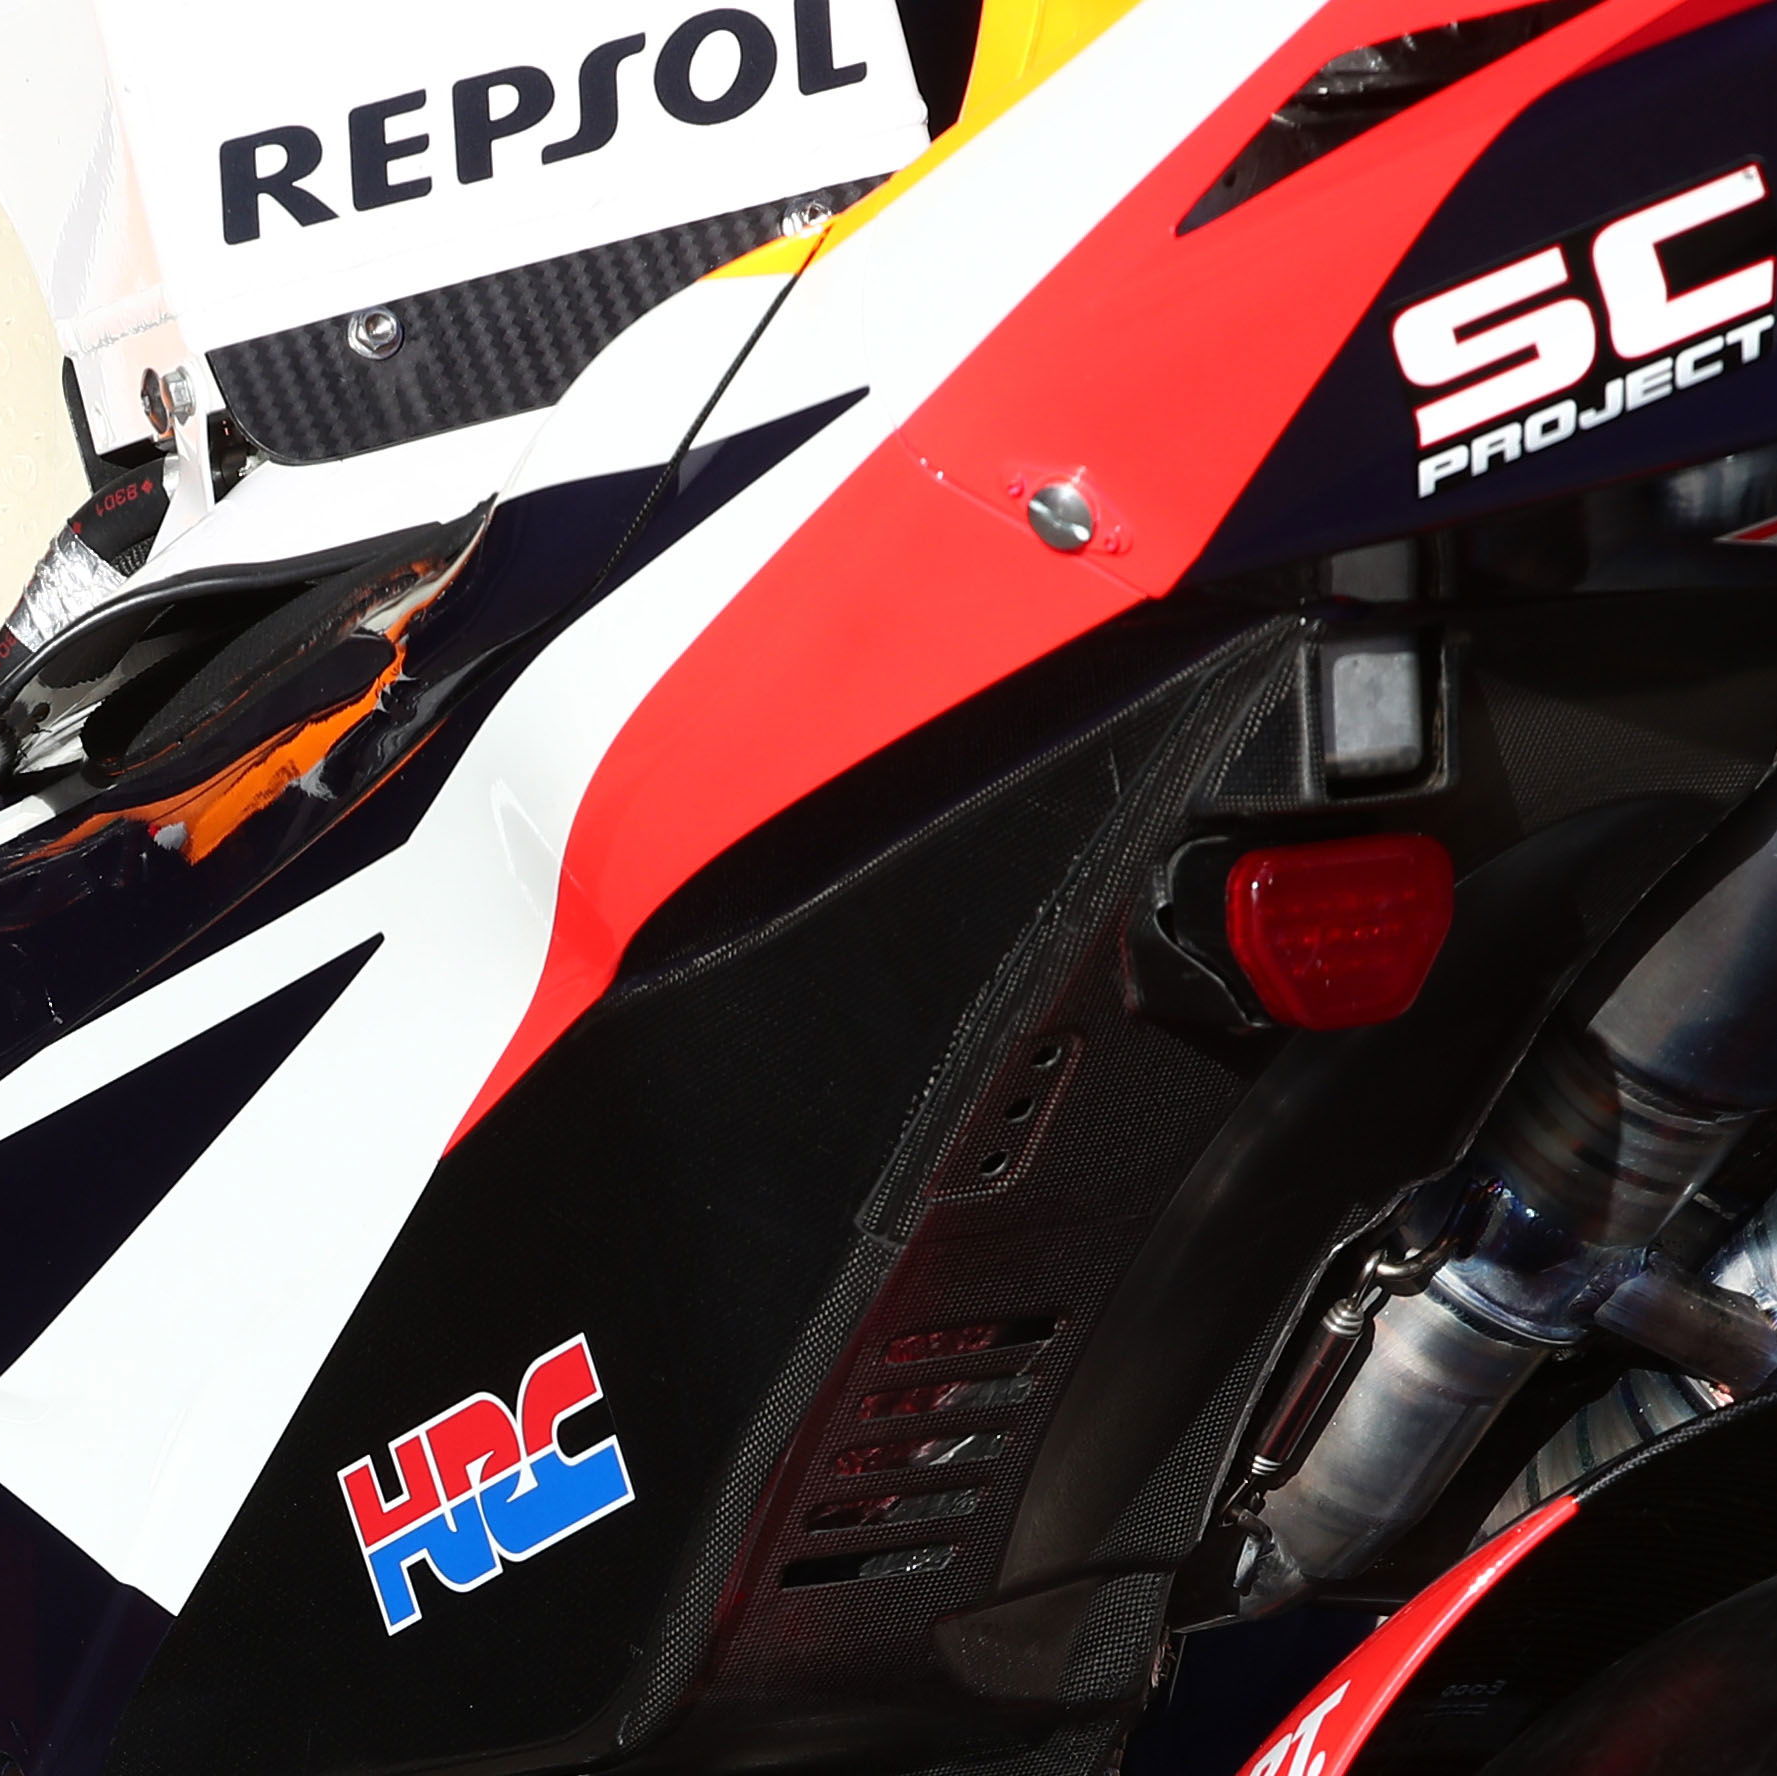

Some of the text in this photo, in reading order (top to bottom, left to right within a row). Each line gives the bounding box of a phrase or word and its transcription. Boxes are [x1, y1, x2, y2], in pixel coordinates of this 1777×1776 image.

[219, 0, 867, 245] REPSOL
[1390, 160, 1776, 449] SC
[1418, 314, 1776, 499] PROJECT
[337, 1332, 636, 1636] HRC
